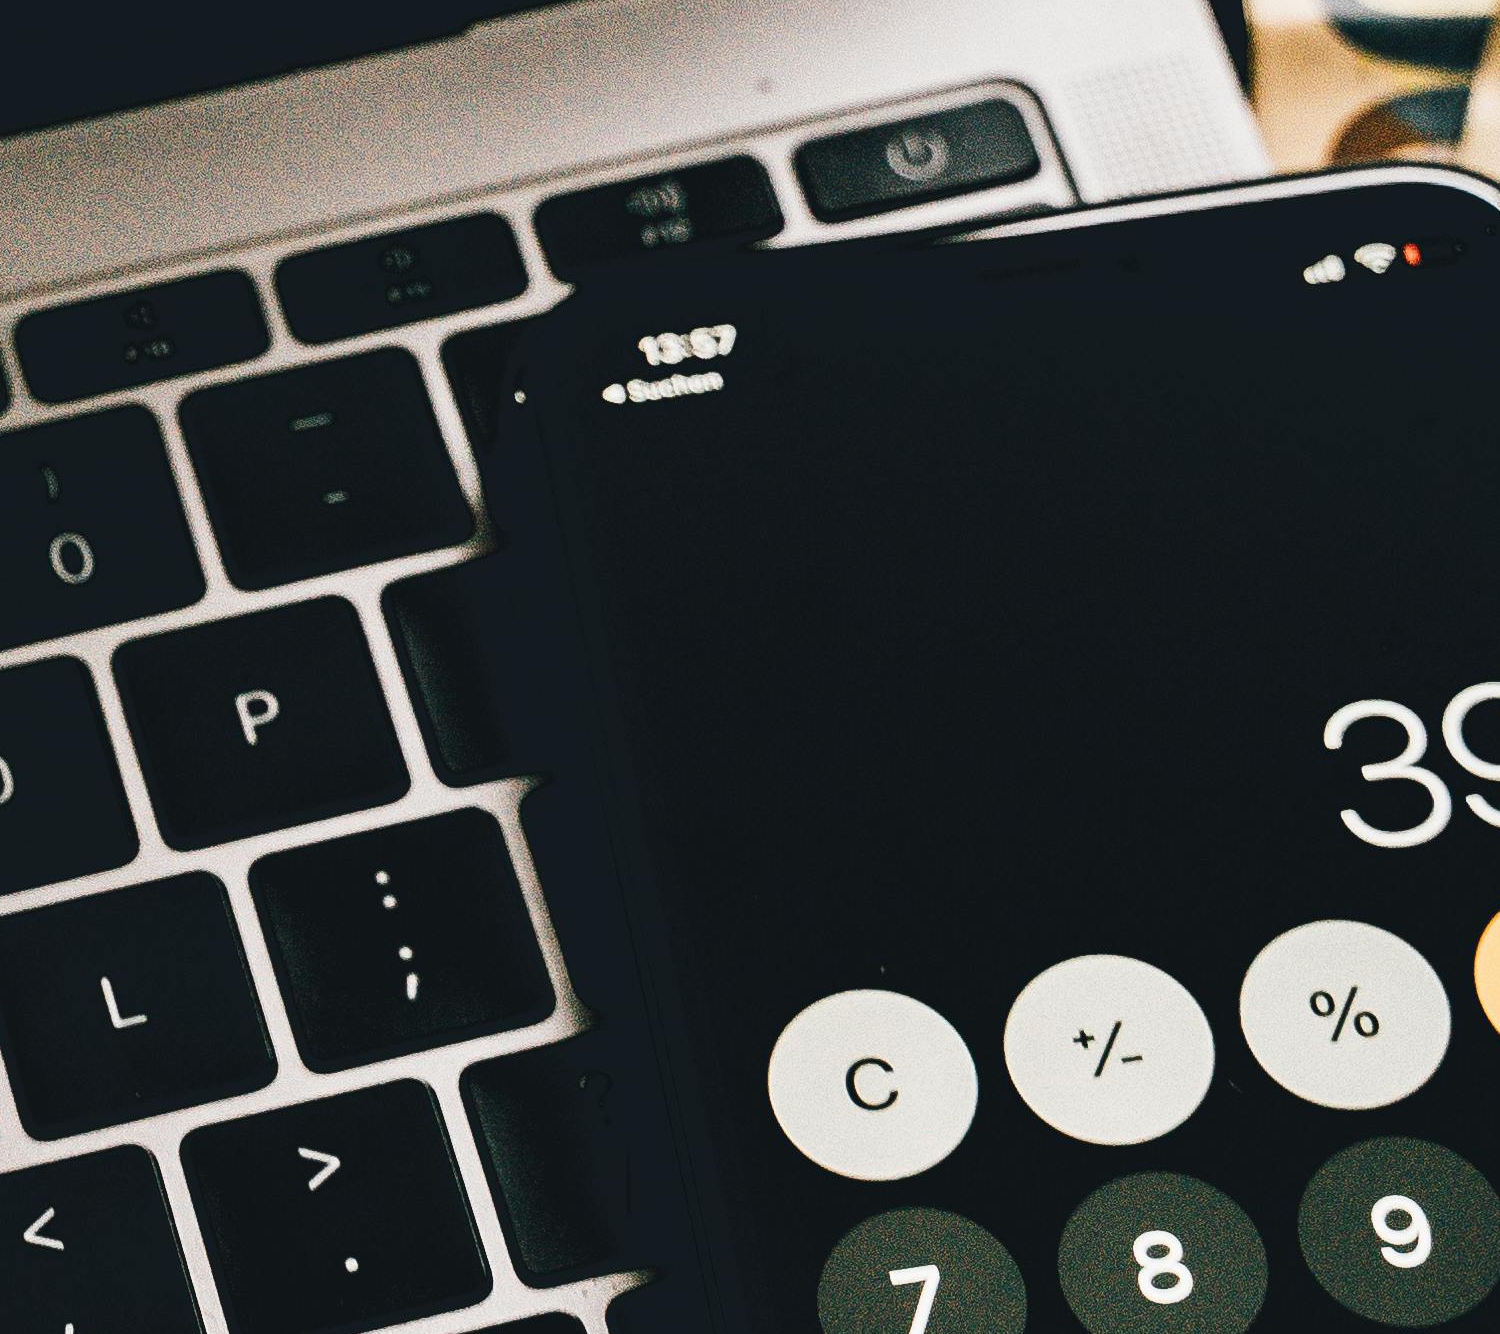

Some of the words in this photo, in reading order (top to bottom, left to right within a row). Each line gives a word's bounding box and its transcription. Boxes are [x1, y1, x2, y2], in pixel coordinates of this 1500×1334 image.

[235, 690, 279, 745] P
[100, 976, 147, 1029] L
[845, 1057, 899, 1112] C
[1370, 1194, 1432, 1269] 9
[1132, 1230, 1194, 1305] 8
